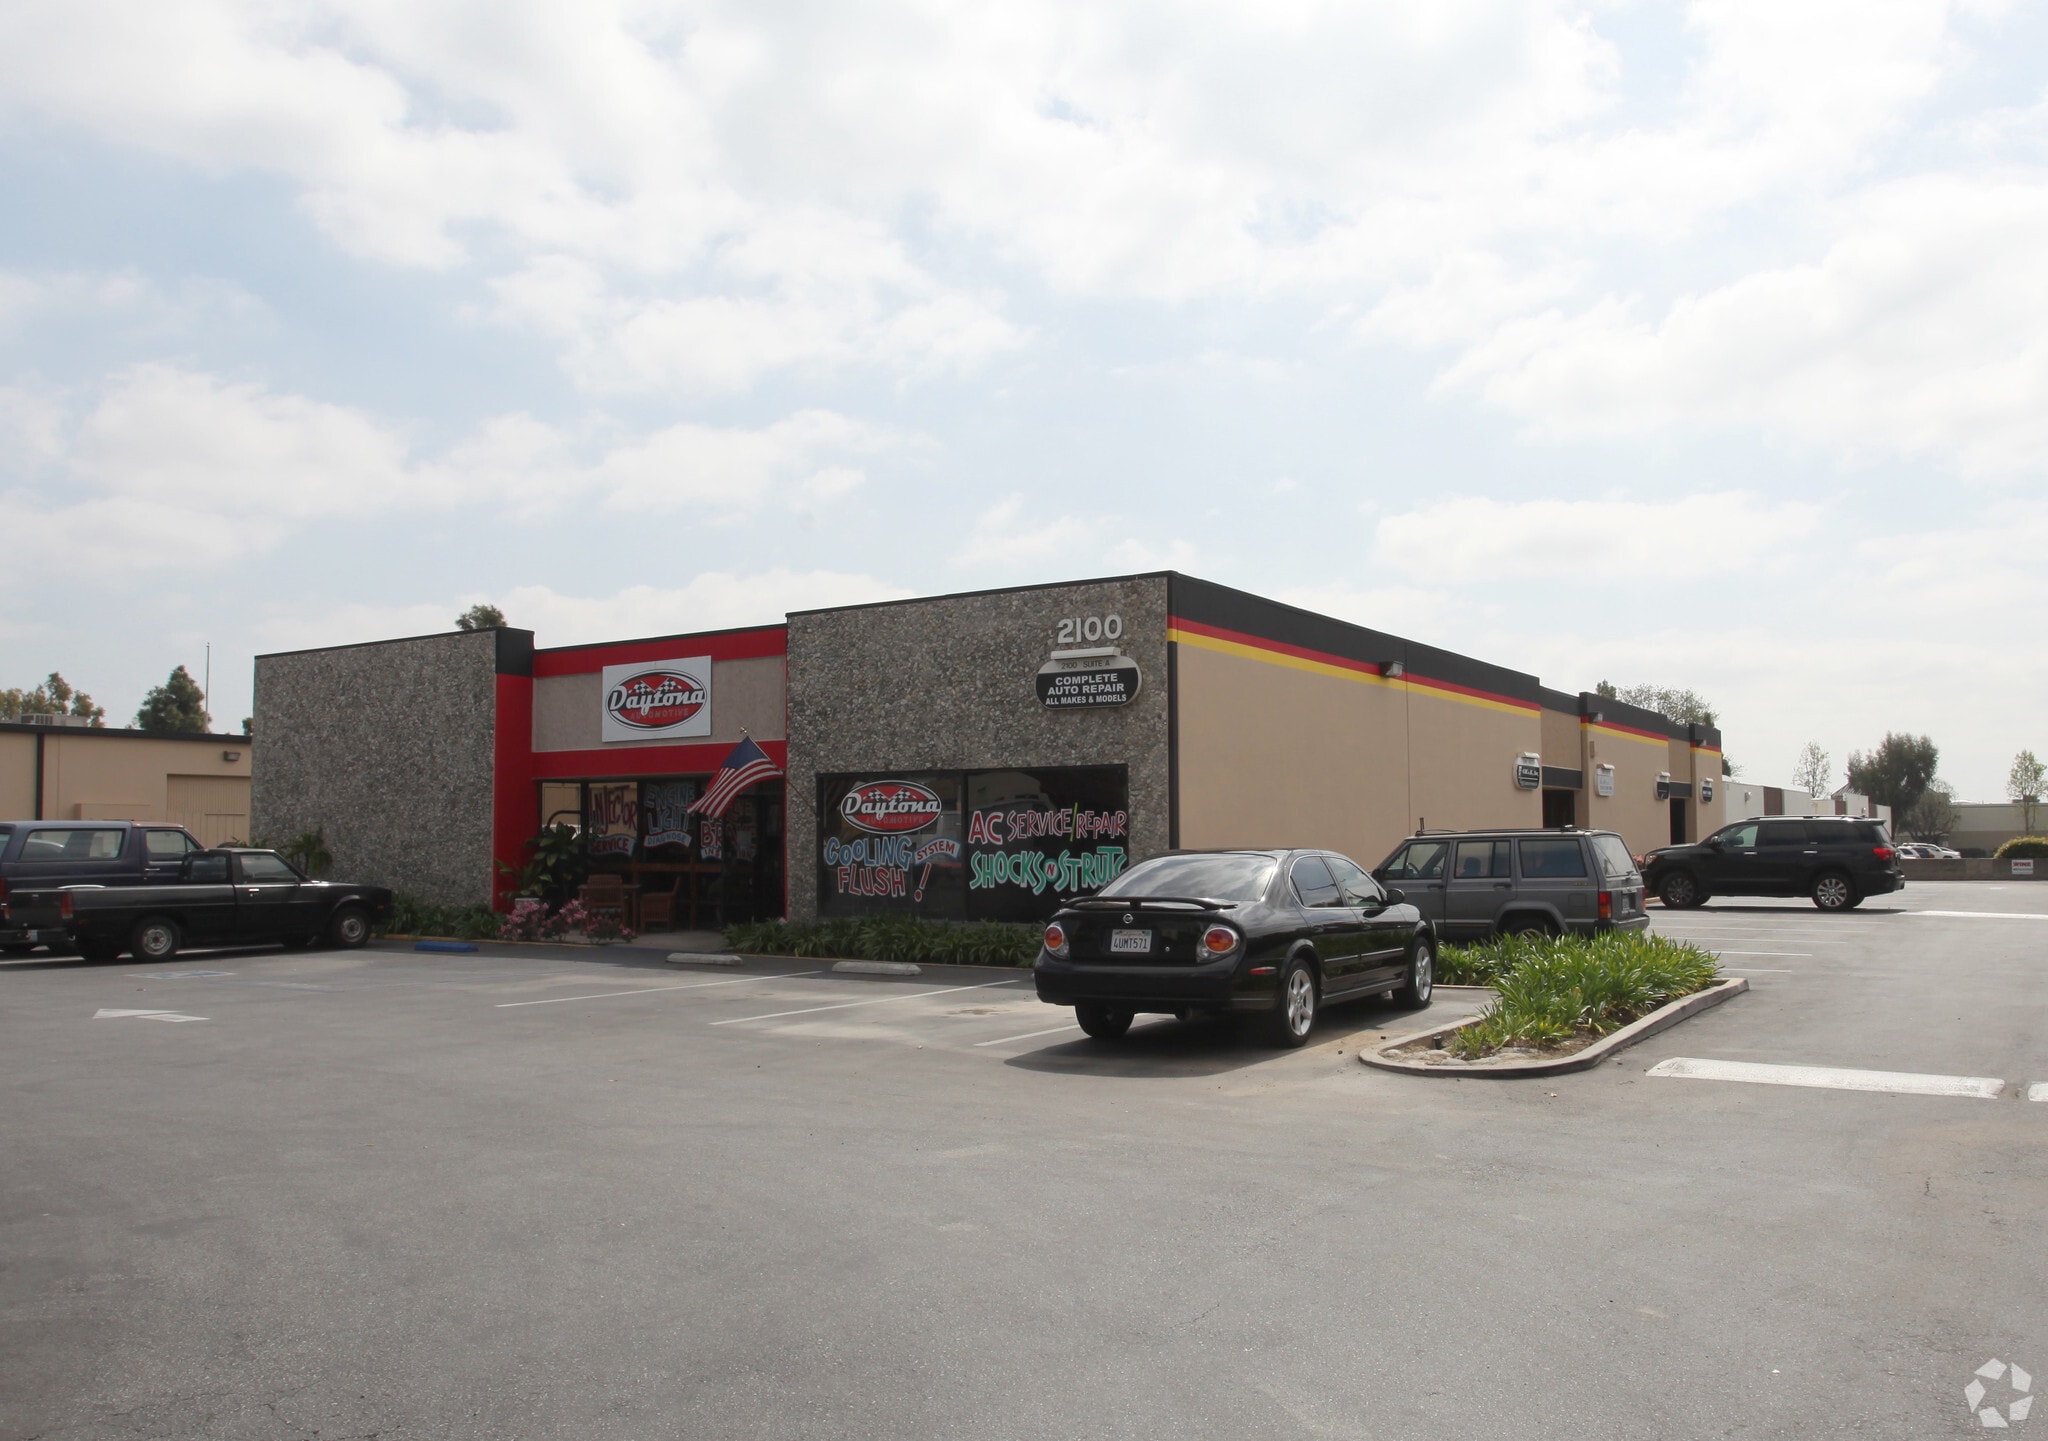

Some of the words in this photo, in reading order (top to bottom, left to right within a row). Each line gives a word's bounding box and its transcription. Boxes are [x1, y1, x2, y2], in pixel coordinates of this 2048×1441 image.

[1056, 614, 1123, 644] 2100
[1061, 662, 1077, 670] 2100
[1082, 660, 1102, 669] SUITE
[1104, 659, 1110, 667] A
[1047, 686, 1079, 696] AUTO
[1082, 683, 1125, 694] REPAIR
[1055, 673, 1118, 686] COMPLETE
[610, 685, 705, 716] Daytona
[1045, 697, 1059, 706] ALL
[1060, 695, 1086, 705] MAKES
[1096, 694, 1127, 703] MODELS
[589, 785, 638, 834] INJECTOR
[643, 783, 696, 810] ENGINE
[845, 792, 940, 820] Daytona
[647, 806, 690, 834] LIGHT
[968, 810, 1004, 845] AC
[647, 832, 687, 846] DIAGNOSE
[825, 837, 912, 871] COOLING
[915, 839, 957, 862] SYSTEM
[969, 849, 1048, 896] SHOCKS
[1113, 937, 1148, 949] 4UMT571
